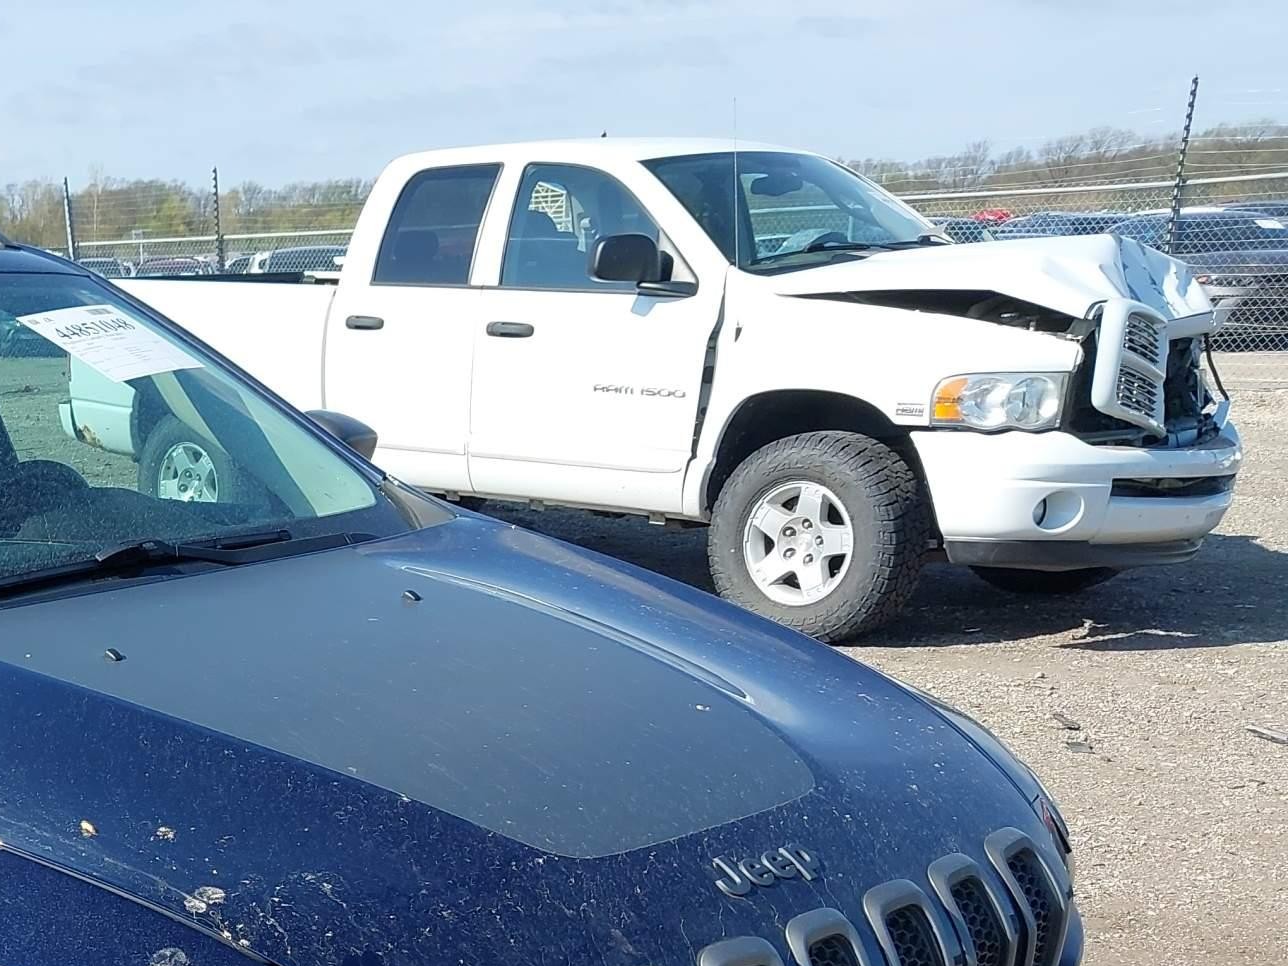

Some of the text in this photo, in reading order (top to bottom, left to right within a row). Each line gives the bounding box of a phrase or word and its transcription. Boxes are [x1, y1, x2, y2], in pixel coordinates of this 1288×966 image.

[55, 318, 137, 340] 44851048
[592, 383, 687, 399] RAM 1500
[712, 846, 820, 896] Jeep
